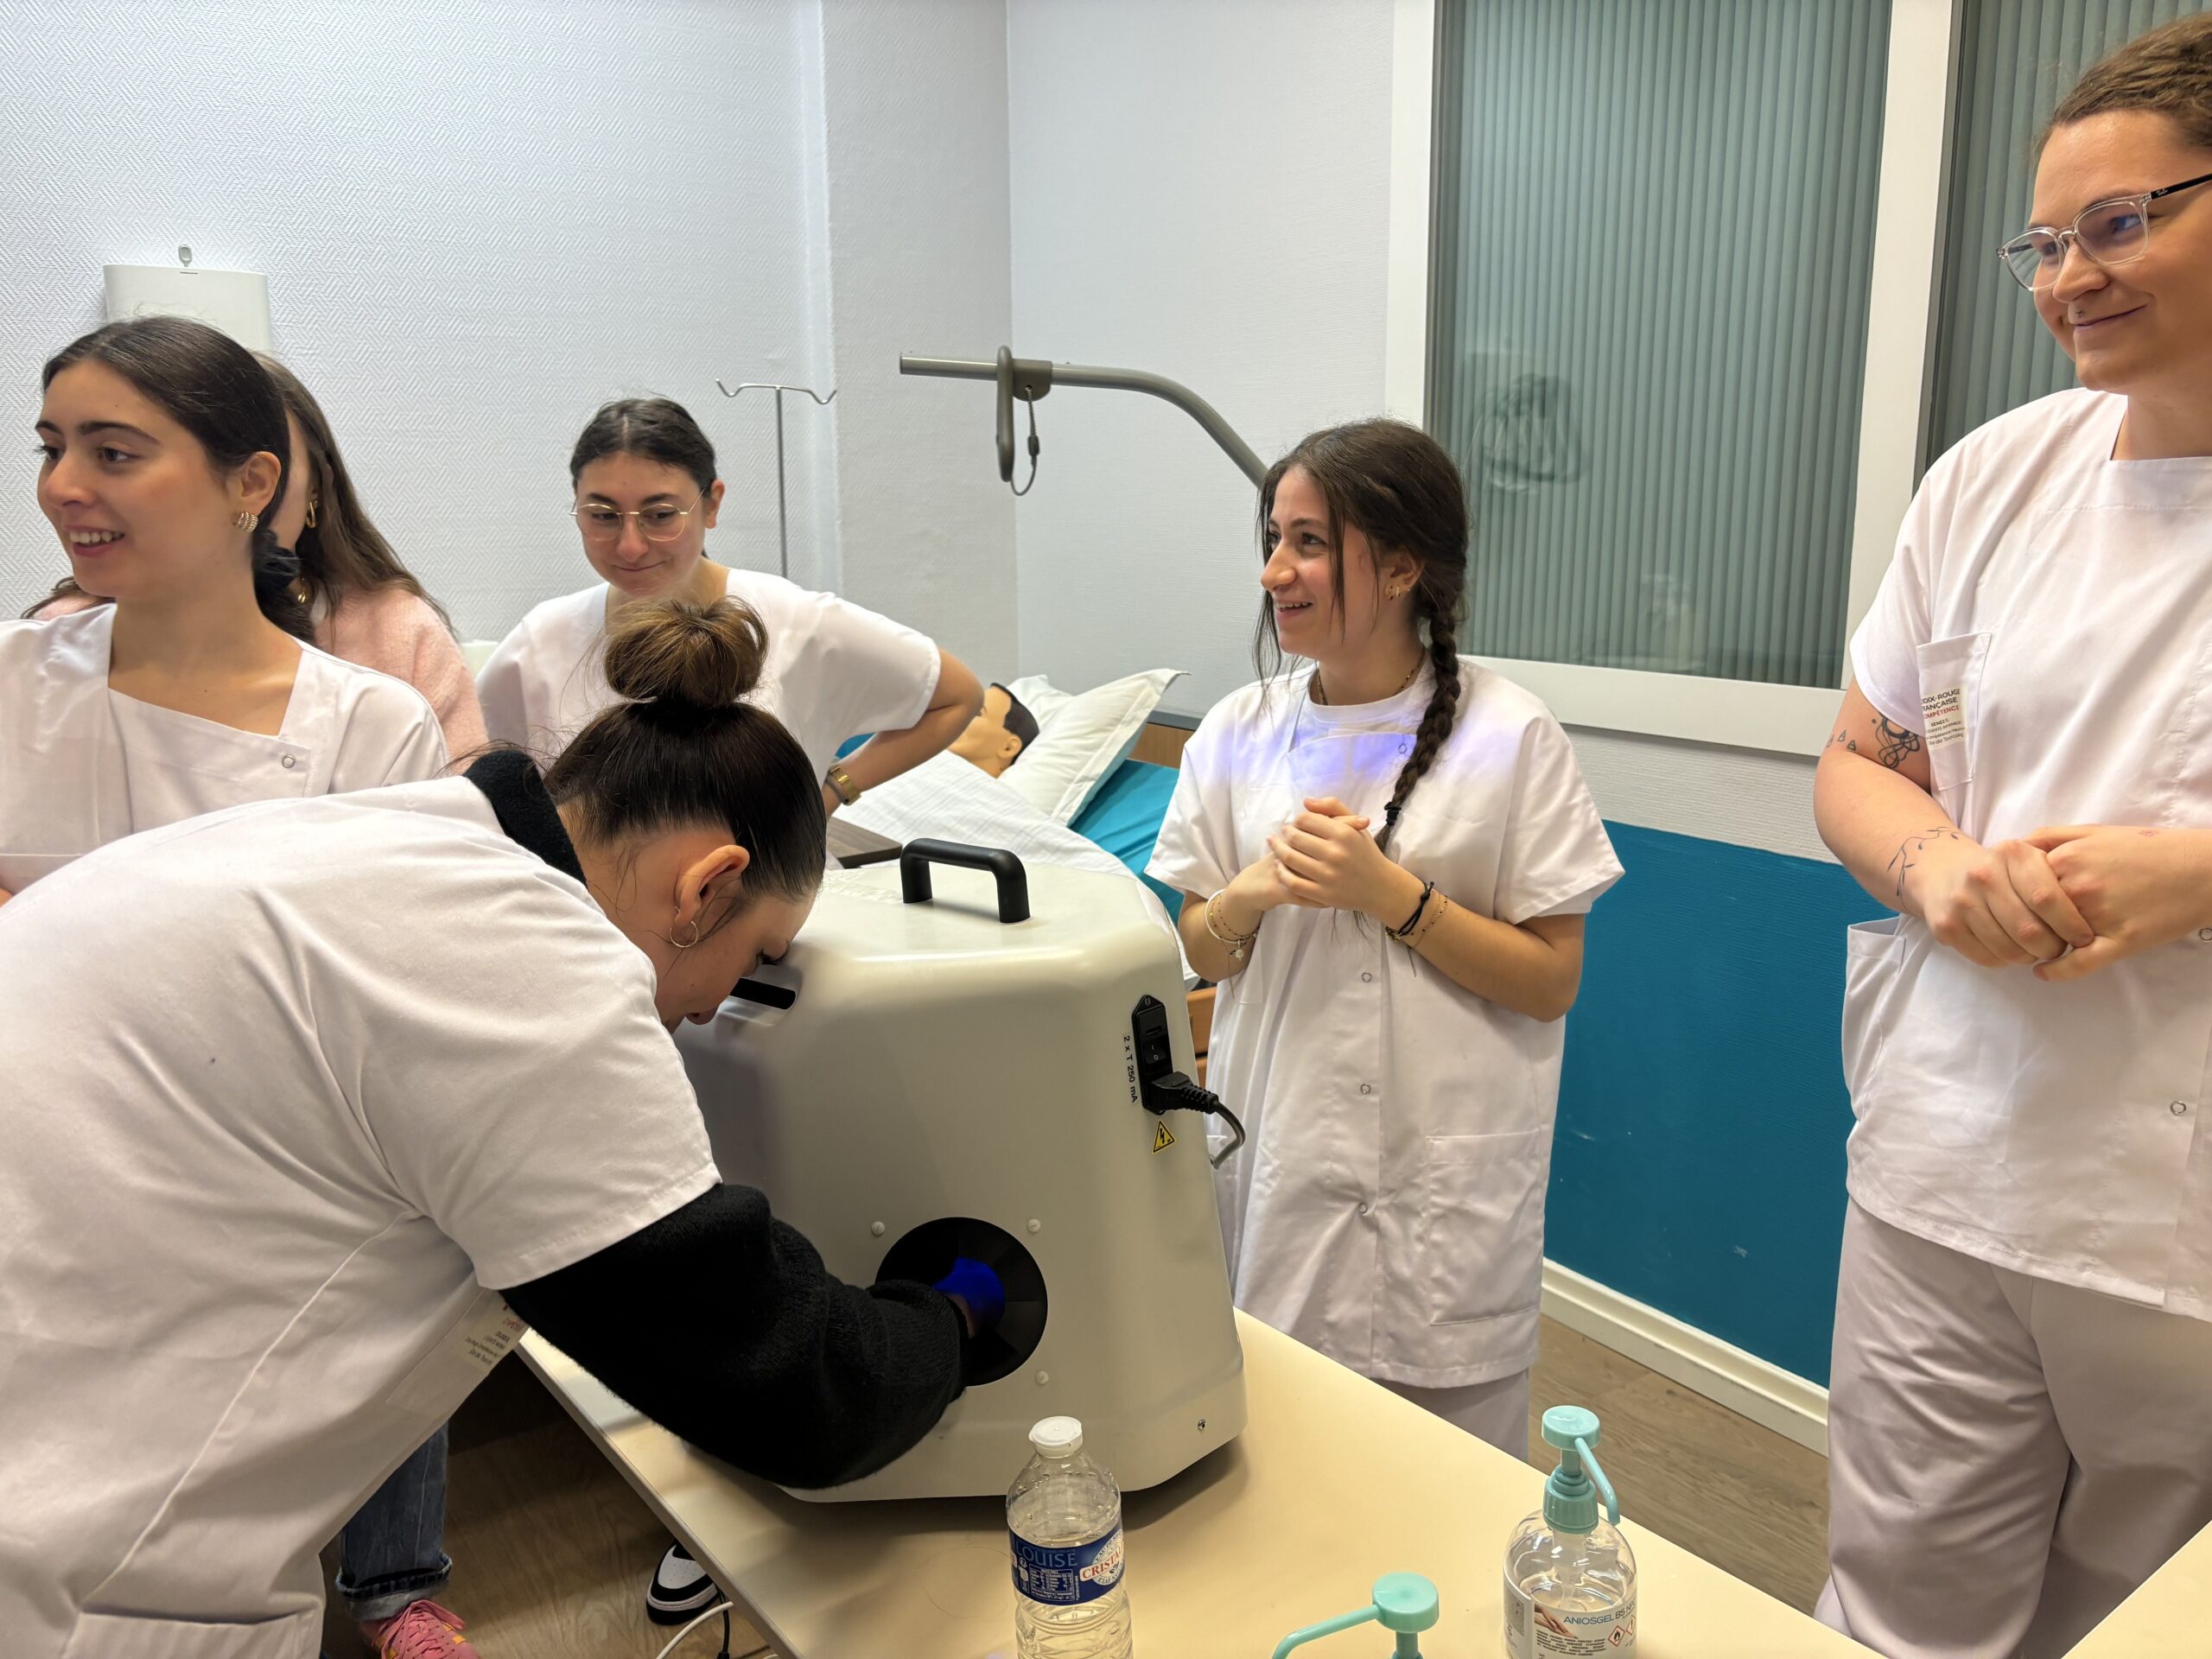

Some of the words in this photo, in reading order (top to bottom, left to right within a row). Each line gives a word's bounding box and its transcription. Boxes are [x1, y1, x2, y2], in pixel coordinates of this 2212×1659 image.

[1127, 1065, 1135, 1083] 250
[1130, 1086, 1138, 1103] mA
[1015, 1541, 1077, 1567] LOUISE
[1563, 1614, 1614, 1625] ANIOSGEL
